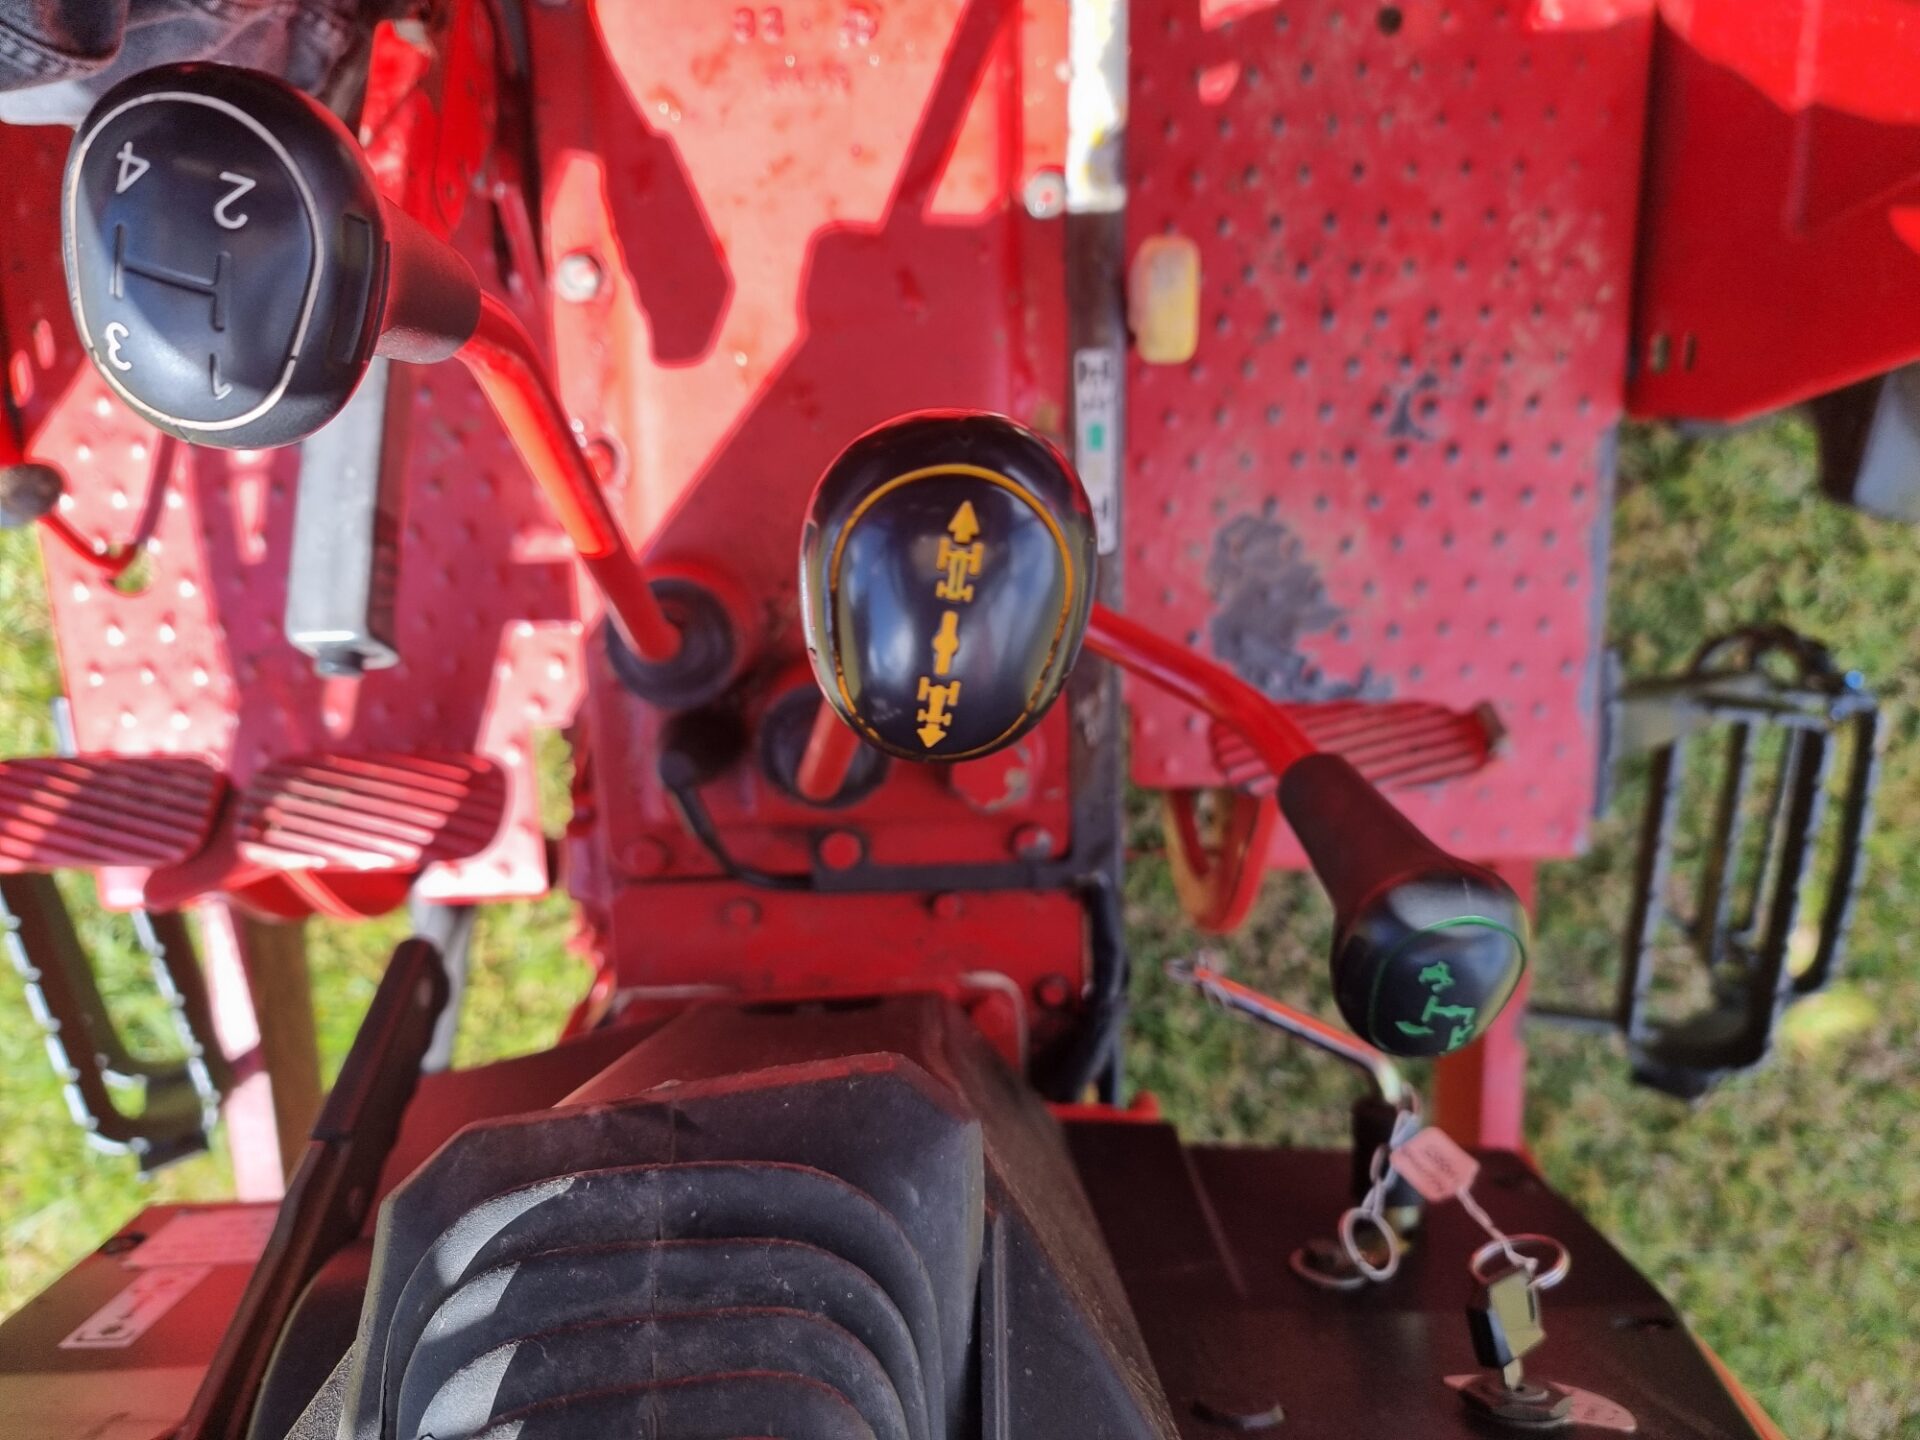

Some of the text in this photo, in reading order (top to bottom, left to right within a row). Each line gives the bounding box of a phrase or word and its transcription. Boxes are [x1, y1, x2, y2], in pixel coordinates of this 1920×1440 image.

[116, 141, 150, 194] 4
[212, 171, 257, 230] 2
[105, 322, 132, 371] 3
[208, 353, 233, 401] 1
